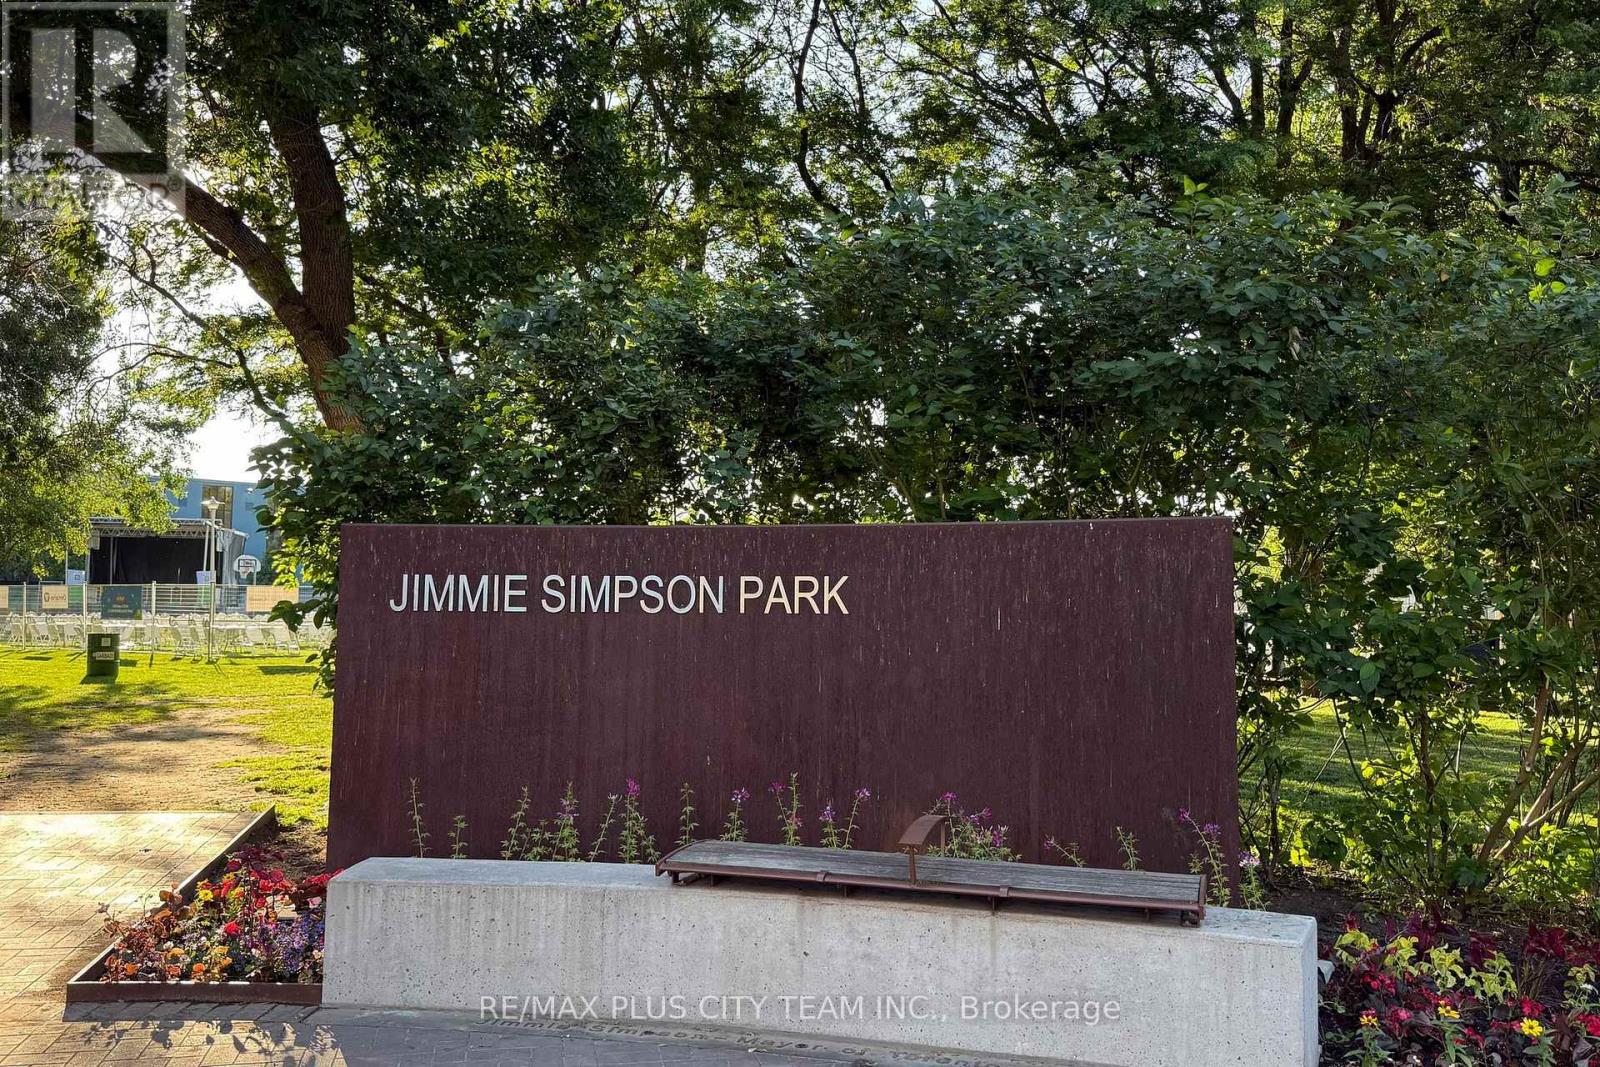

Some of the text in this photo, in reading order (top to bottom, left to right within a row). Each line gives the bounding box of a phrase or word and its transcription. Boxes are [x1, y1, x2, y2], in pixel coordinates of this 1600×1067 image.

[389, 573, 849, 615] JIMMIE SIMPSON PARK
